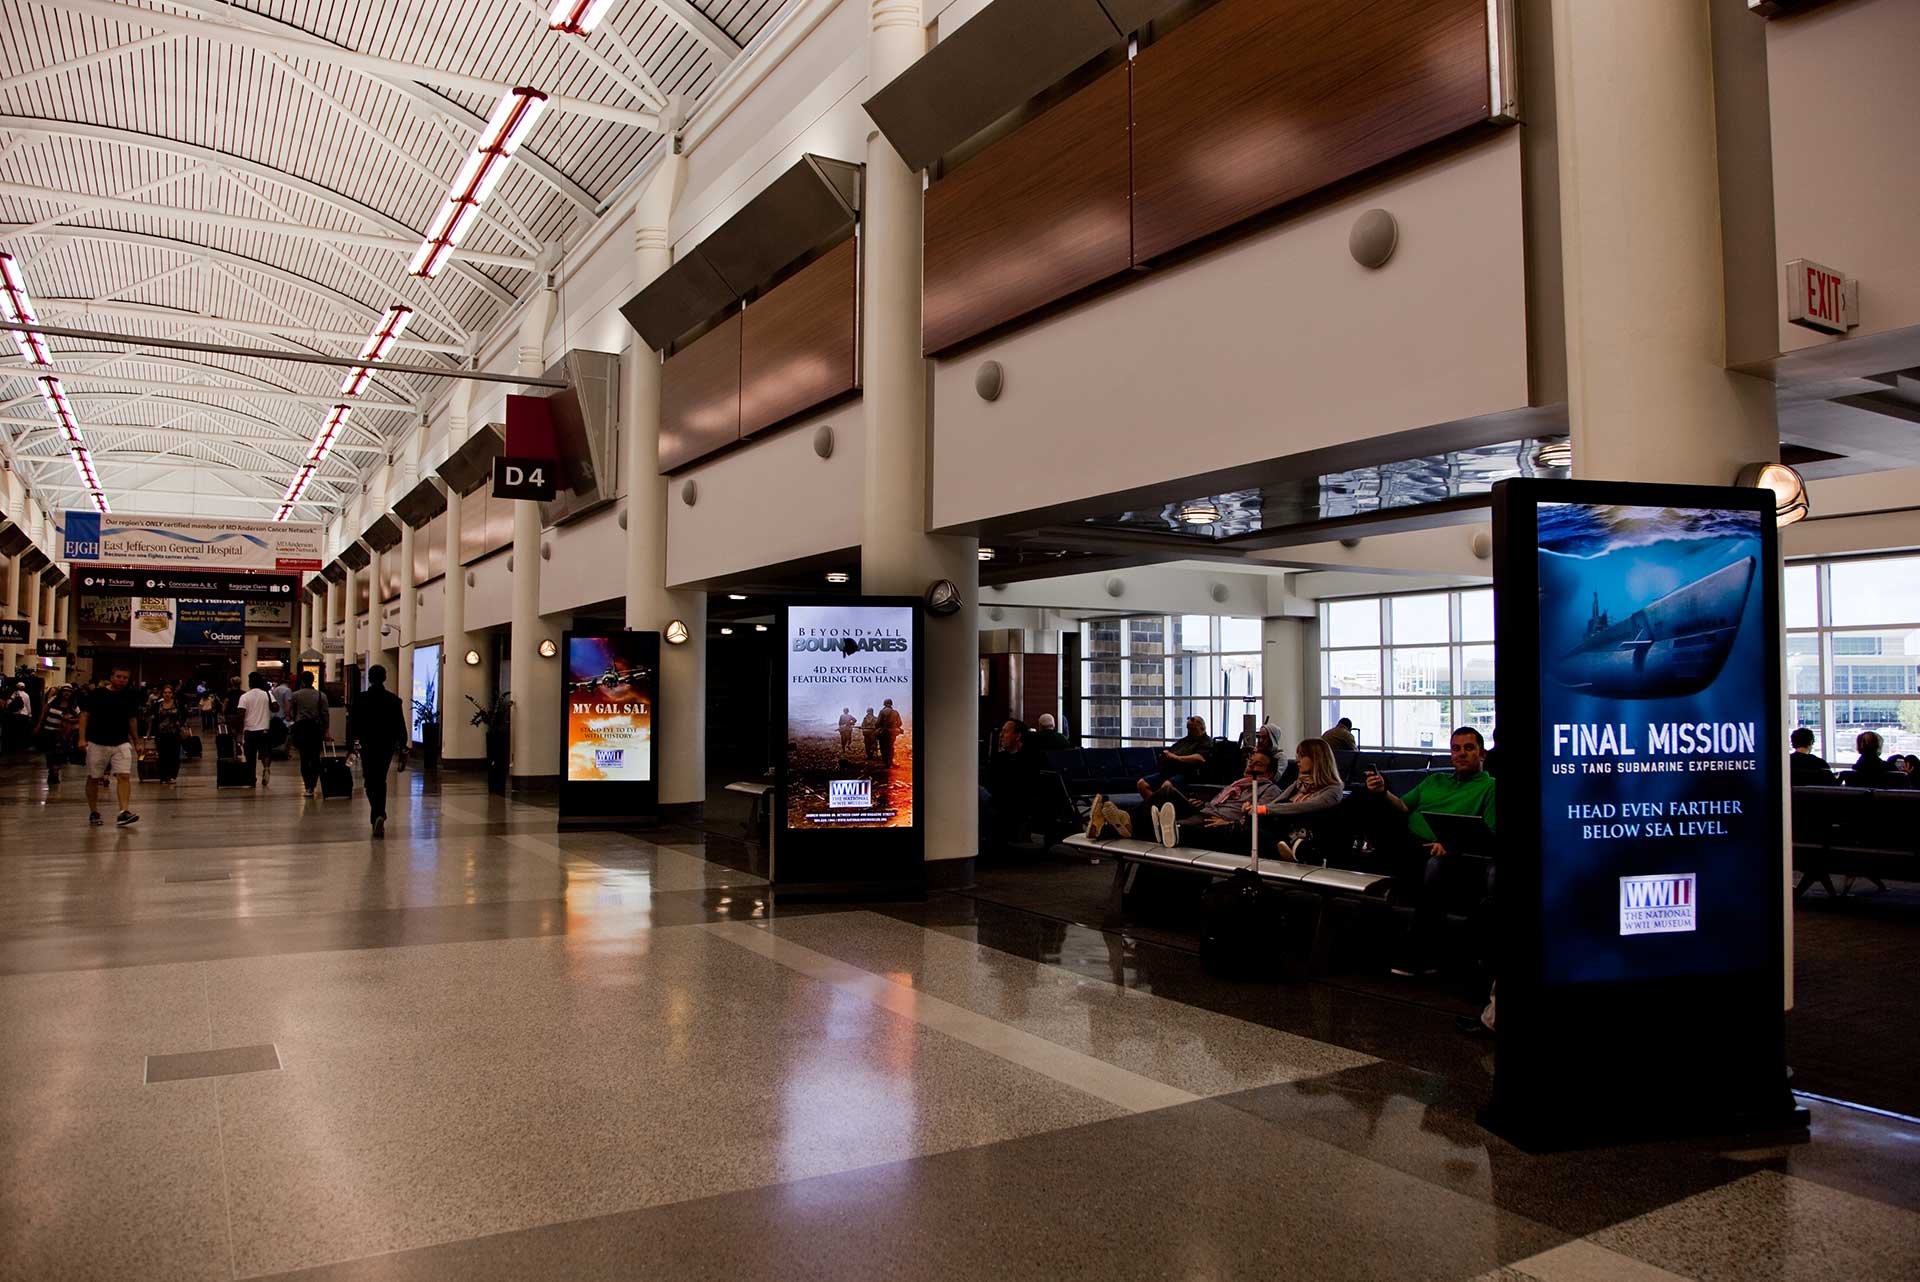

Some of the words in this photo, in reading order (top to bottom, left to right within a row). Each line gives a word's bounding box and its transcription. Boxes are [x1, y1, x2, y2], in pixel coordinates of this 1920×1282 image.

[1807, 267, 1841, 323] EXIT
[506, 466, 545, 487] D4
[164, 521, 190, 529] certified
[65, 541, 99, 557] EJGH
[104, 540, 124, 551] East
[124, 541, 167, 553] Jefferson
[169, 543, 204, 554] General
[207, 545, 243, 557] Hospital
[108, 578, 134, 586] Ticketing
[168, 580, 198, 588] Concourses
[210, 632, 242, 641] Ochsner
[798, 627, 863, 637] BEYOND
[874, 627, 901, 637] ALL
[792, 638, 908, 653] BOUNDARIES
[813, 666, 827, 674] 4D
[830, 666, 887, 674] EXPERIENCE
[793, 675, 847, 683] FEATURING
[851, 675, 873, 683] TOM
[875, 675, 909, 683] HANKS
[573, 704, 592, 714] MY
[595, 703, 620, 714] GAL
[624, 703, 648, 714] SAL
[1553, 722, 1636, 757] FINAL
[1648, 721, 1756, 756] MISSION
[597, 751, 622, 760] WWII
[1552, 763, 1576, 774] USS
[1582, 763, 1612, 774] TANG
[1617, 761, 1684, 773] SUBMARINE
[1689, 760, 1756, 772] EXPERIENCE
[832, 782, 867, 795] WWII
[1567, 803, 1616, 819] HEAD
[1622, 802, 1663, 817] EVEN
[1669, 800, 1743, 816] FARTHER
[1583, 823, 1641, 839] BELOW
[1645, 822, 1674, 838] SEA
[1679, 821, 1729, 836] LEVEL.
[1626, 879, 1690, 908] WWII
[1625, 911, 1643, 920] THE
[1645, 909, 1692, 919] NATIONAL
[1624, 921, 1650, 930] WWII
[1654, 919, 1692, 929] MUSEUM
